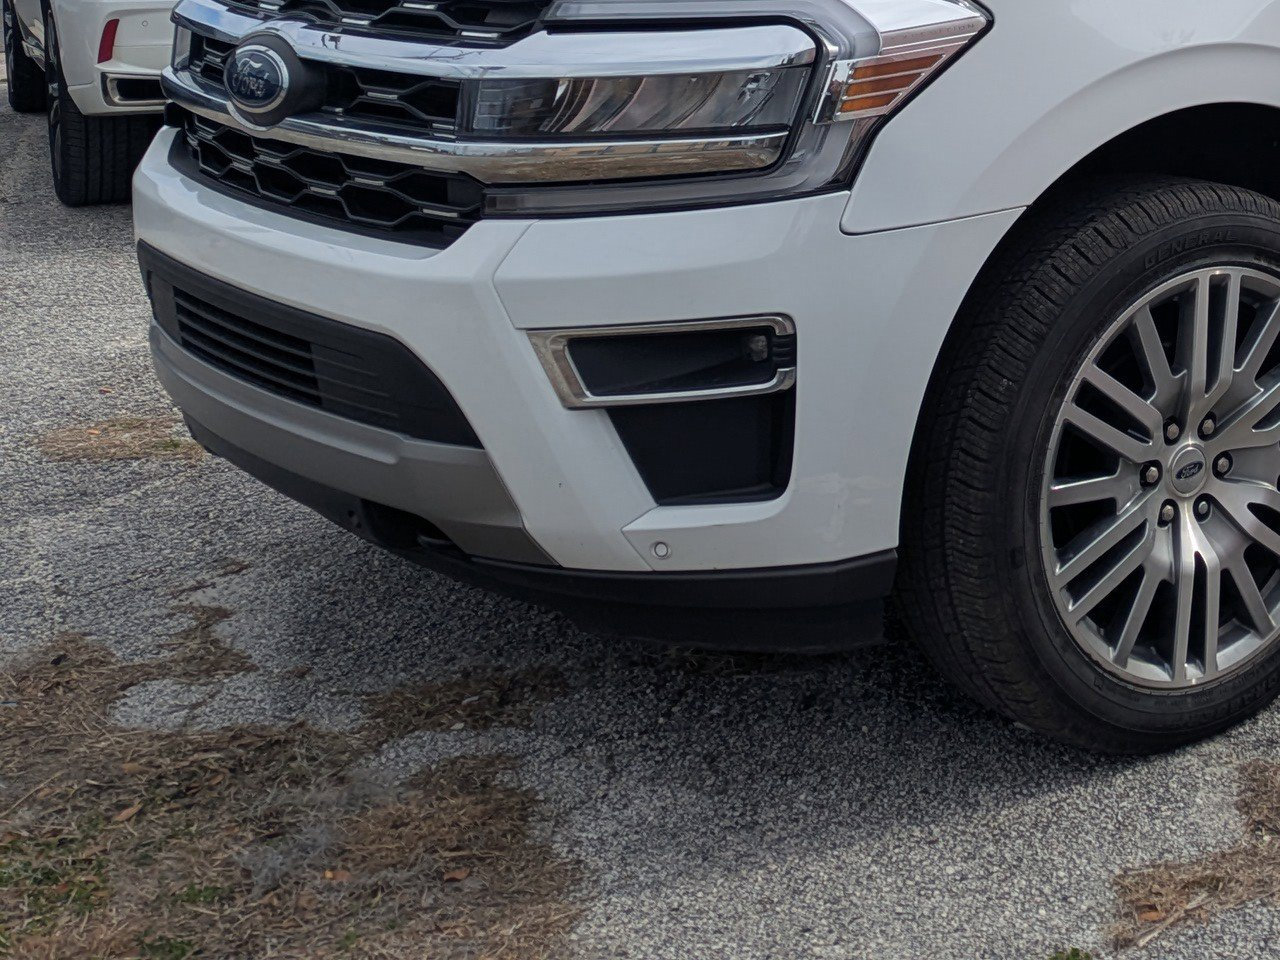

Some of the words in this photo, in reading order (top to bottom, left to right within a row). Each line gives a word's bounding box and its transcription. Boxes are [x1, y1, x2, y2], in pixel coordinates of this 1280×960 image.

[232, 58, 269, 98] Ford
[1144, 230, 1239, 268] GENERAL
[1179, 462, 1202, 480] Ford
